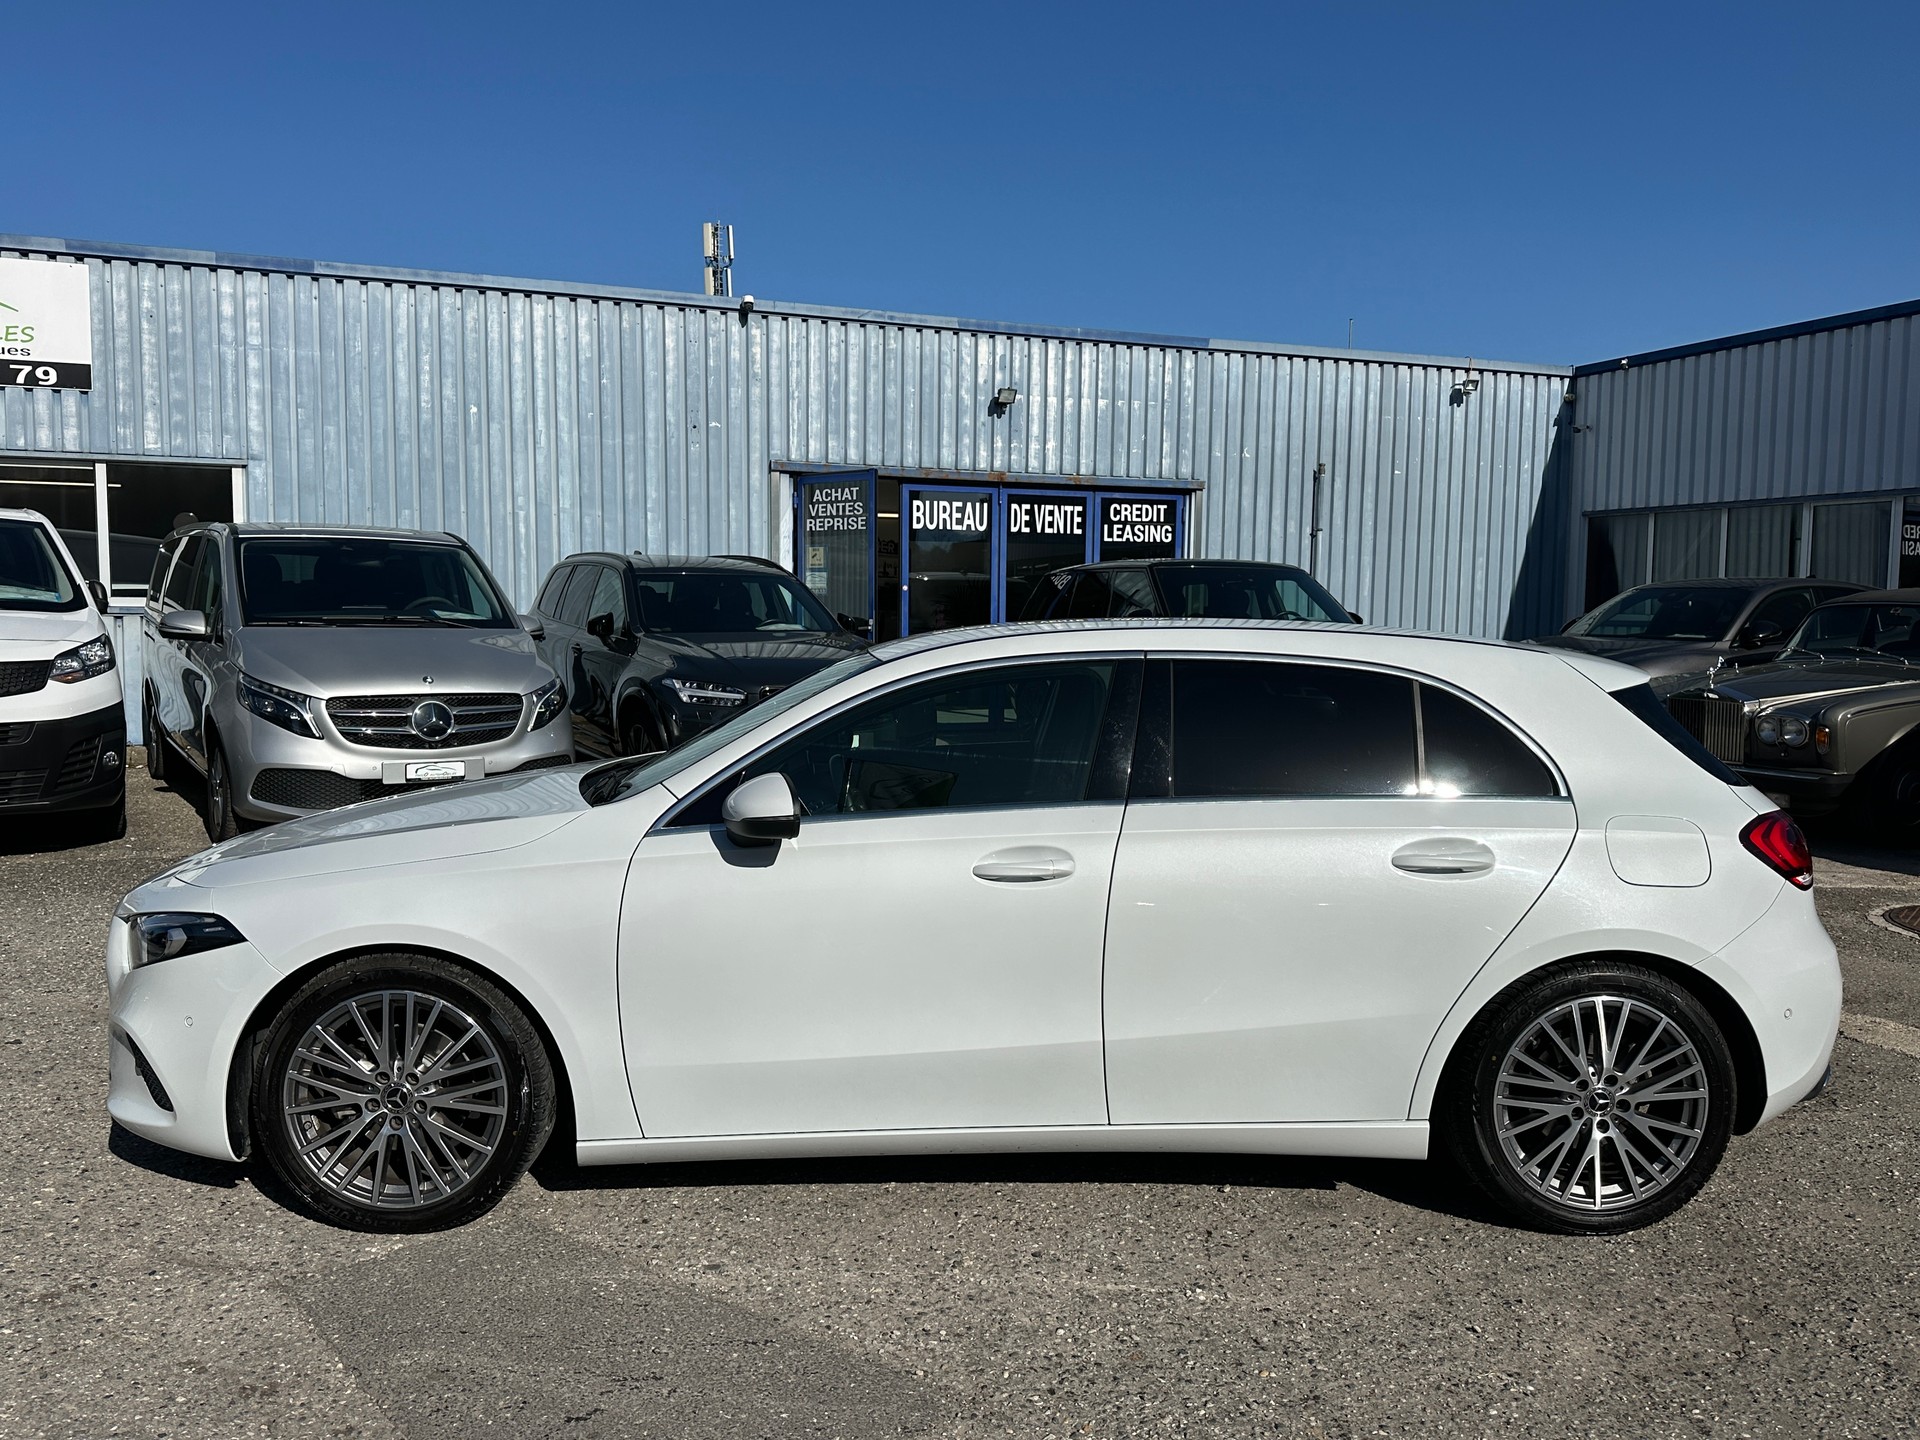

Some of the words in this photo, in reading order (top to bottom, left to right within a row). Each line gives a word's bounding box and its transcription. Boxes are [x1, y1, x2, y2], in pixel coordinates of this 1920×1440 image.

[0, 326, 35, 342] ES
[9, 364, 58, 386] 79
[813, 487, 859, 502] ACHAT
[809, 502, 863, 516] VENTES
[912, 500, 988, 532] BUREAU
[1010, 503, 1031, 533] DE
[1034, 504, 1083, 535] VENTE
[1109, 503, 1168, 522] CREDIT
[806, 517, 867, 531] REPRISE
[1103, 524, 1173, 543] LEASING
